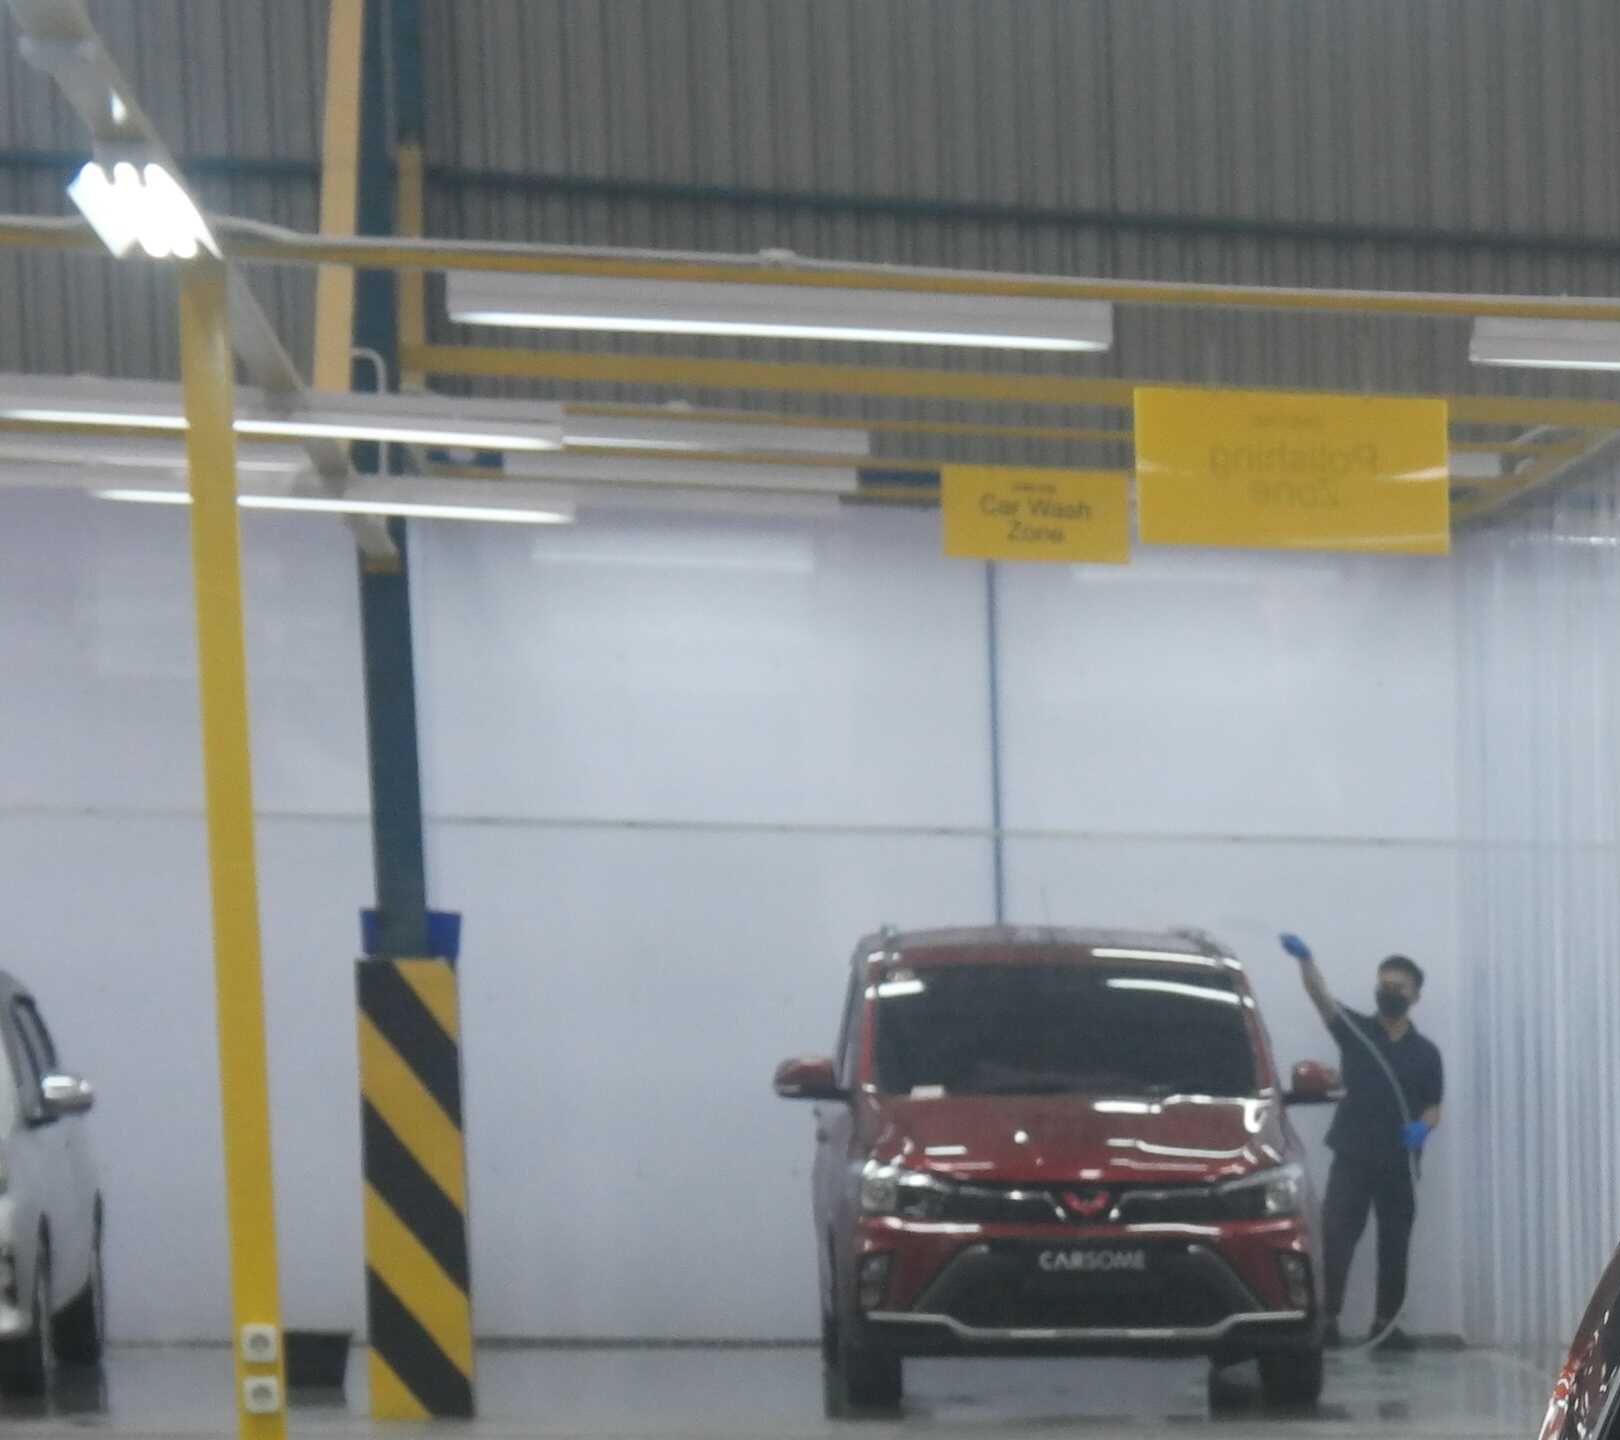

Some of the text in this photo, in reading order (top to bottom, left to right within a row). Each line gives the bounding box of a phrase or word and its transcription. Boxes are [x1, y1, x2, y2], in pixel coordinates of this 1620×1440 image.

[979, 492, 1092, 519] Car Wash
[1007, 520, 1065, 543] Zone
[1038, 1249, 1146, 1271] CARSOME
